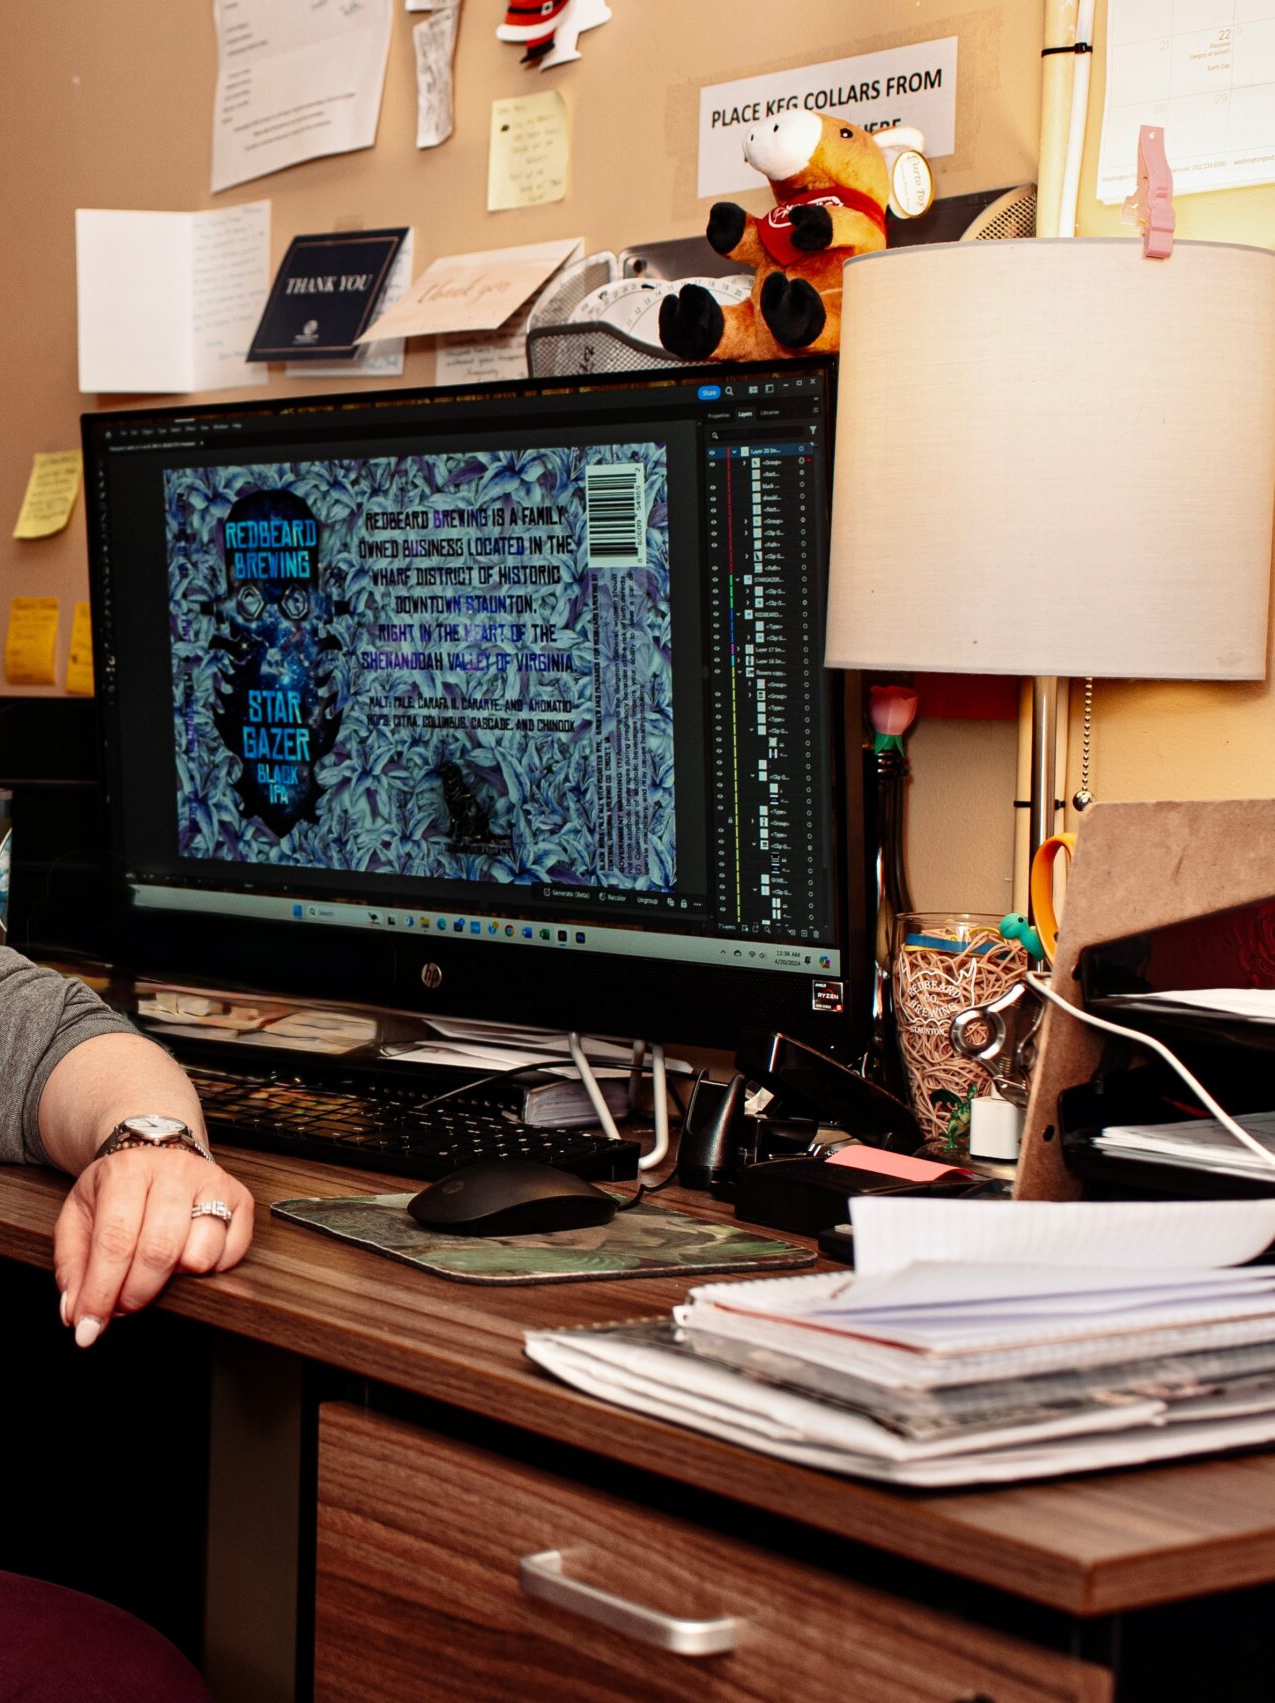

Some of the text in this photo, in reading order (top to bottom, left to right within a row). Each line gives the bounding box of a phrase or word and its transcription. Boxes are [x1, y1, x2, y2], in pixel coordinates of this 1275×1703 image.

[1218, 29, 1231, 40] 22
[711, 102, 761, 128] PLACE
[803, 80, 881, 111] COLLARS
[885, 68, 943, 97] FROM
[286, 273, 373, 295] THANK YOU
[702, 389, 717, 397] Share
[738, 410, 753, 418] Layers
[365, 506, 566, 531] REDBEARD BREWING IS A FAMILY
[226, 519, 317, 548] REDBEARD
[358, 534, 574, 559] OWNED BUSINESS LOCATED IN THE
[234, 551, 310, 580] BREWING
[372, 565, 561, 587] WHARF DISTRICT OF HISTORIC
[395, 595, 537, 614] DOWNTOWN STAUNTON.
[378, 623, 558, 643] RIGHT IN THE HEART OF THE
[361, 651, 443, 671] SHENANDOAH
[448, 652, 492, 671] VALLEY
[496, 653, 510, 671] OF
[248, 689, 302, 724] STAR
[537, 718, 575, 733] CHINOOK
[242, 726, 311, 761] GAZER
[257, 762, 299, 784] BLACK
[269, 783, 289, 805] IPA
[617, 815, 626, 874] GOVERNMENT
[552, 889, 574, 898] Generate
[607, 894, 626, 902] Recolor
[637, 896, 659, 905] Ungroup
[774, 959, 801, 967] 4/20/2024
[817, 992, 839, 1000] RYZEN
[908, 980, 962, 999] REDBEARD
[909, 1000, 959, 1019] BREWING
